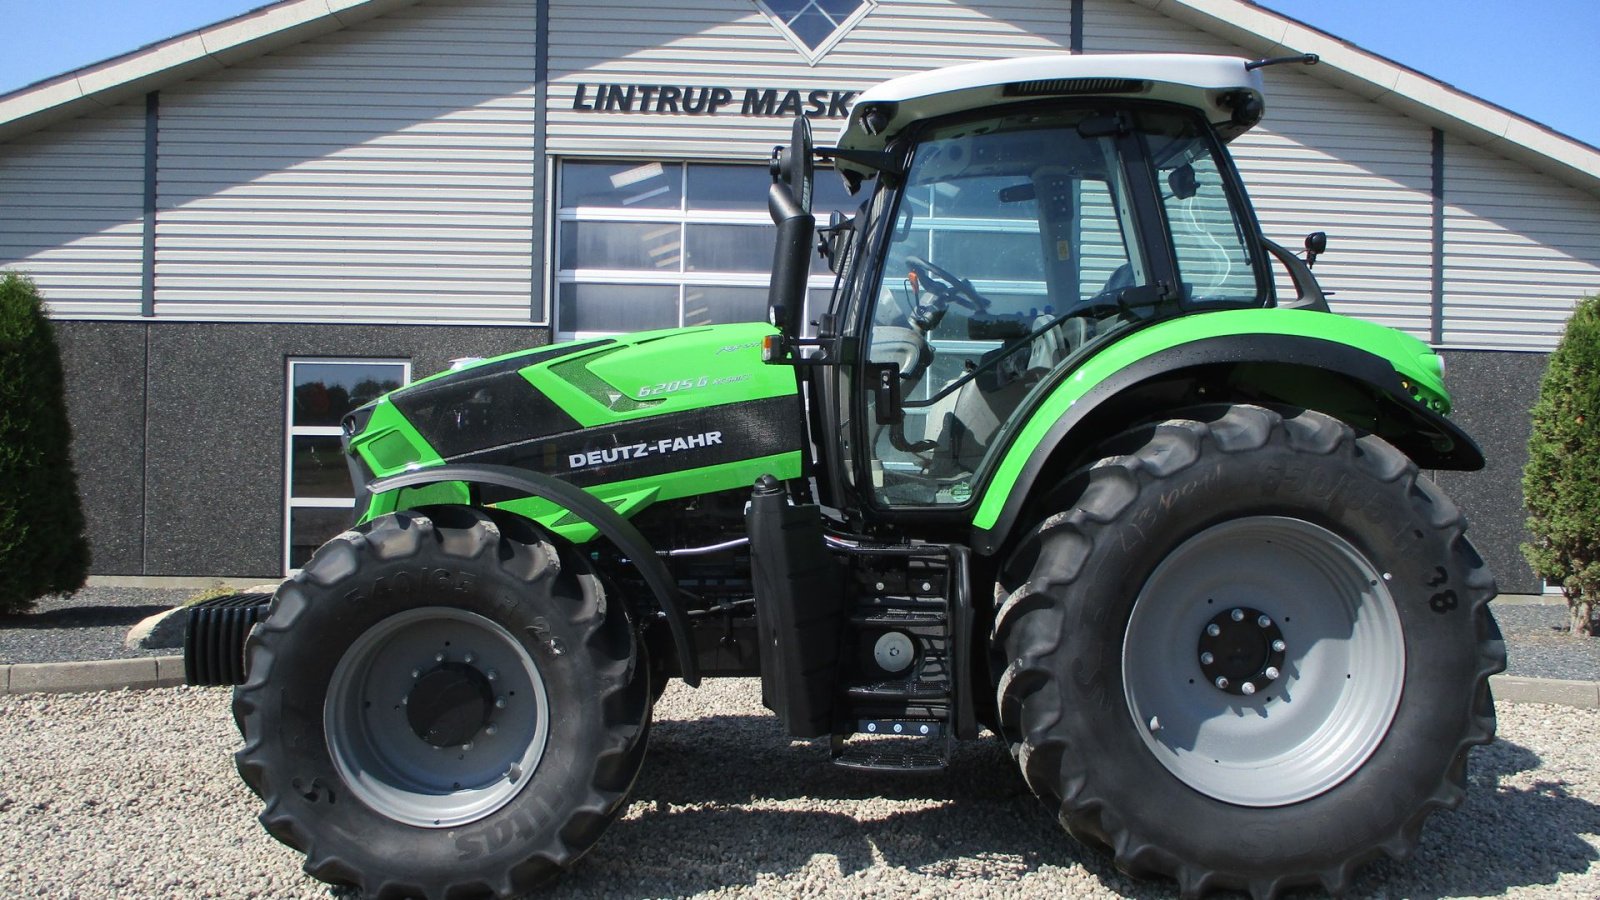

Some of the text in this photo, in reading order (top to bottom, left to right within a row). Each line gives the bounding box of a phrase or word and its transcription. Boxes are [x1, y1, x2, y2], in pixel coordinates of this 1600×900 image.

[573, 83, 732, 113] LINTRUP
[637, 379, 693, 397] 6205
[568, 430, 722, 468] DEUTZ-FAHR
